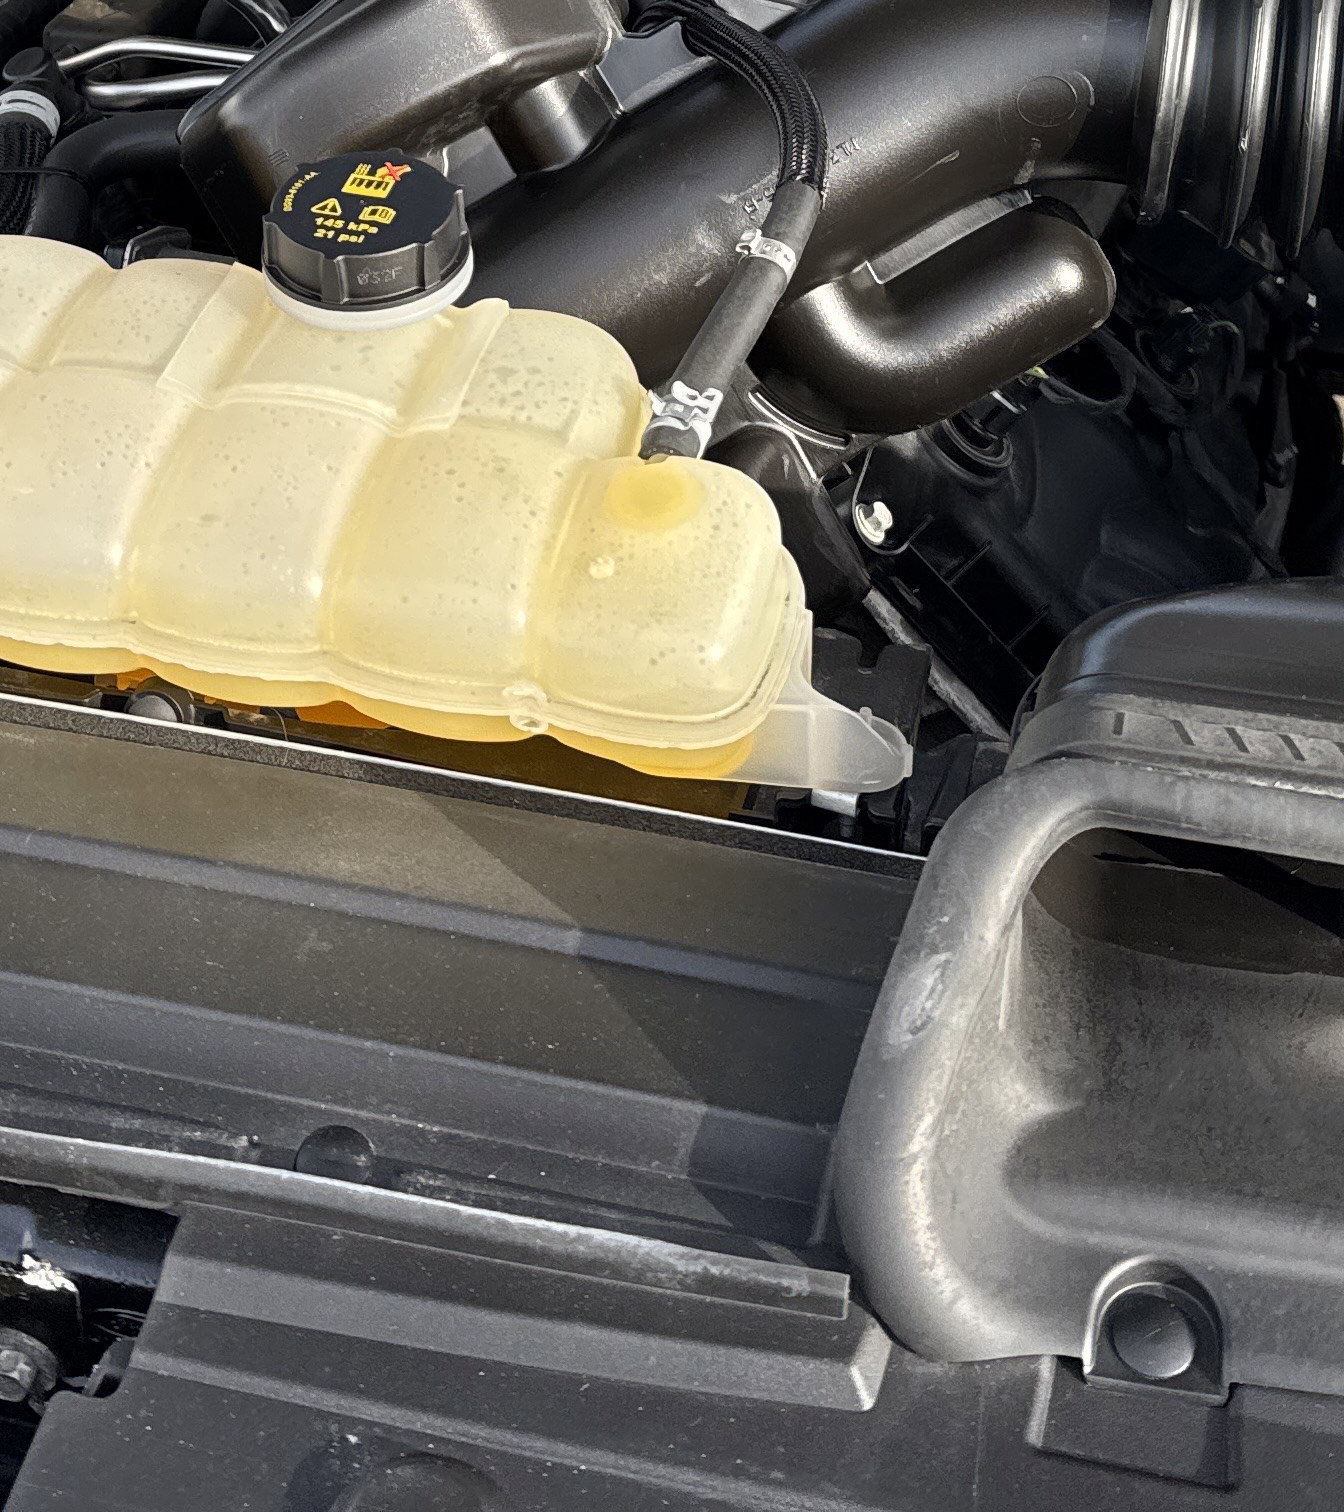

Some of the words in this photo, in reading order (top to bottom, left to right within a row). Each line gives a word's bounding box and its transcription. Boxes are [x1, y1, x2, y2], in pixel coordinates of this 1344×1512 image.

[314, 216, 346, 229] 145
[346, 221, 379, 234] kPa
[313, 228, 336, 239] 21
[337, 233, 365, 244] psi
